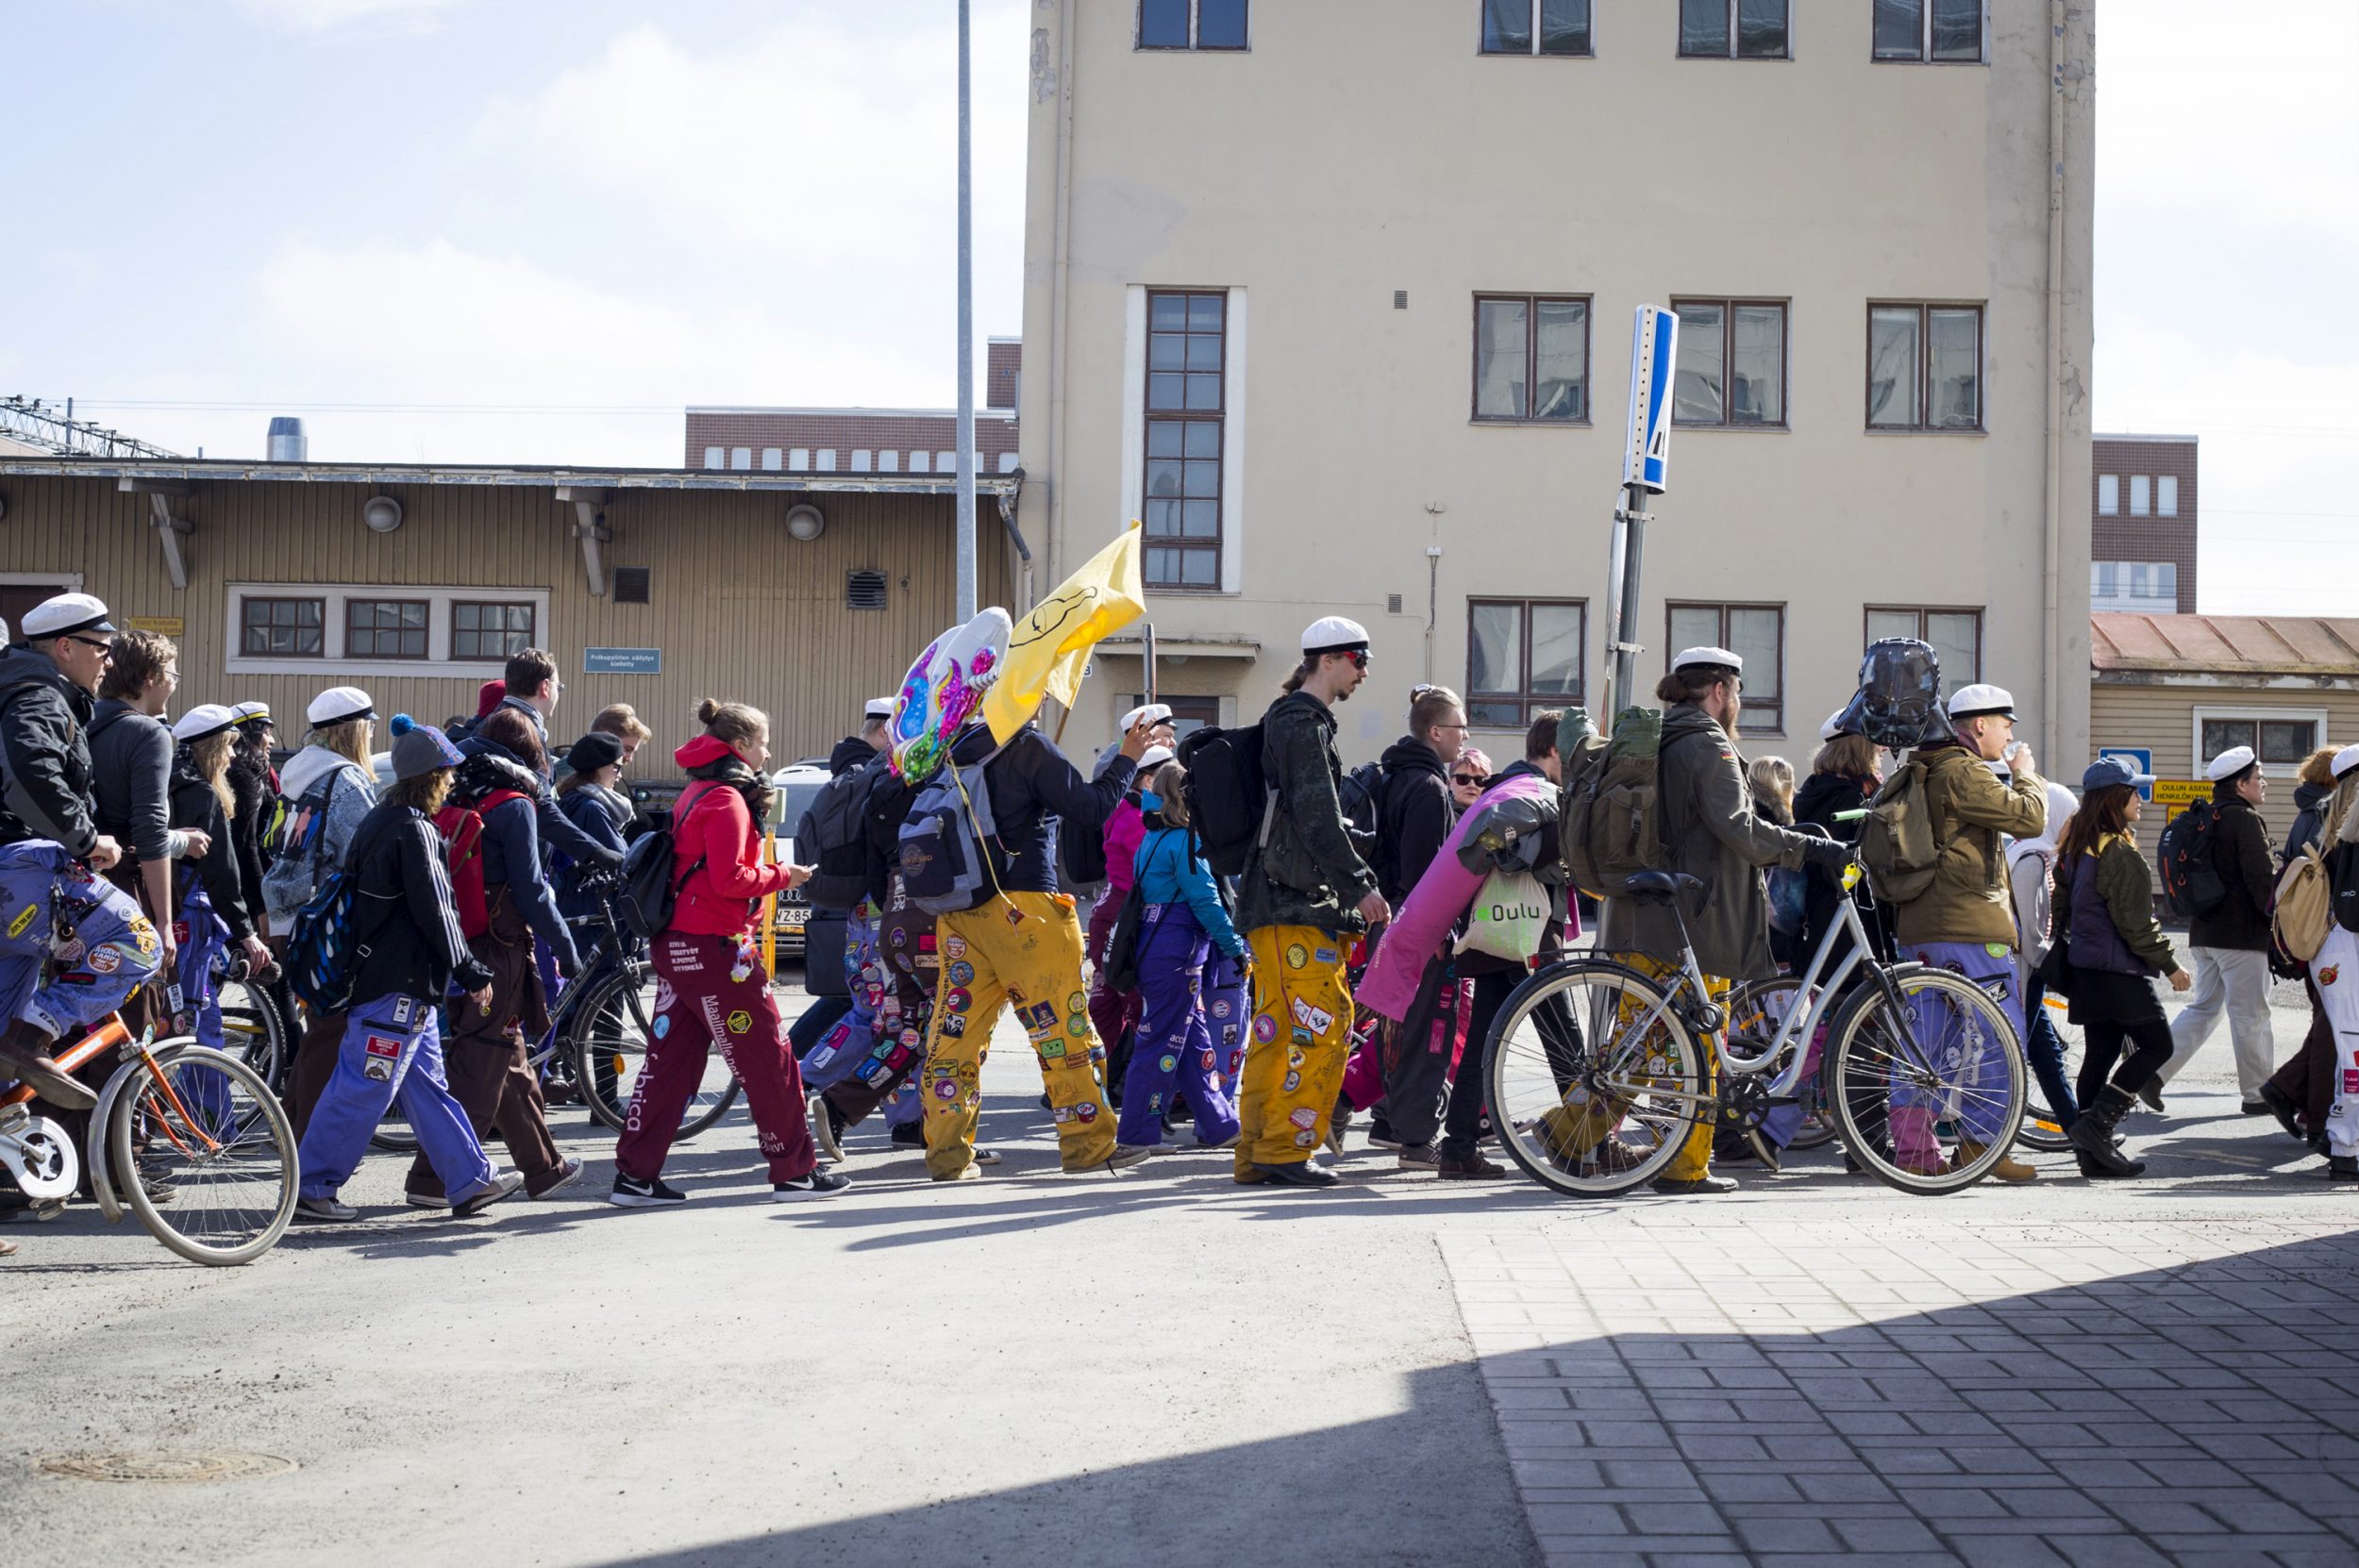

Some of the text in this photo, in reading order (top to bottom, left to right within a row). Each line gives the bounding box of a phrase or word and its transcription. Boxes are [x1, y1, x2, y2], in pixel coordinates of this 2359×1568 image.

[1492, 903, 1540, 921] Oulu
[706, 994, 740, 1076] Maailmalle.net
[924, 1065, 932, 1088] GEA
